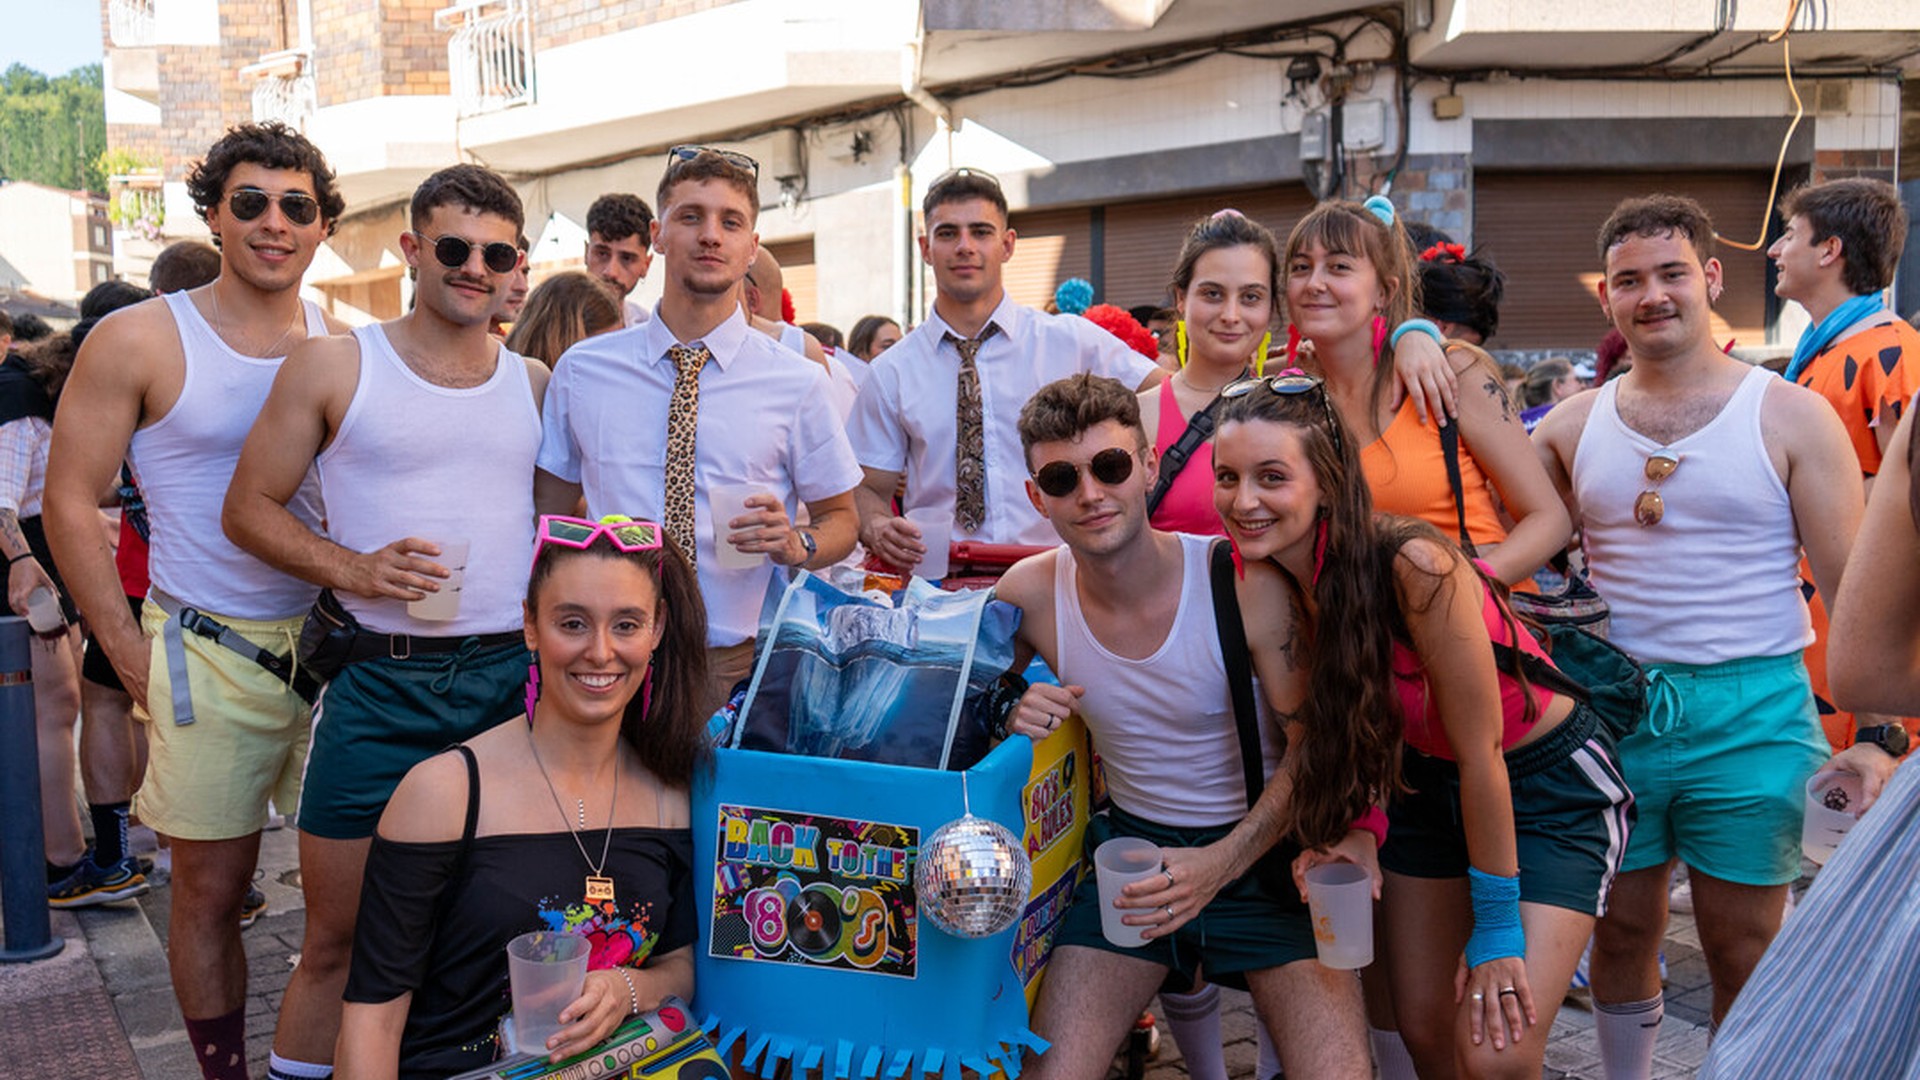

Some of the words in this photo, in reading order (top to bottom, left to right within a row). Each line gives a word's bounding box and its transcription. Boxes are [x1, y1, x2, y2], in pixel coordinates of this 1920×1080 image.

[725, 817, 818, 870] BACK
[827, 838, 860, 874] TO
[861, 844, 909, 882] THE
[1040, 790, 1074, 849] RULES
